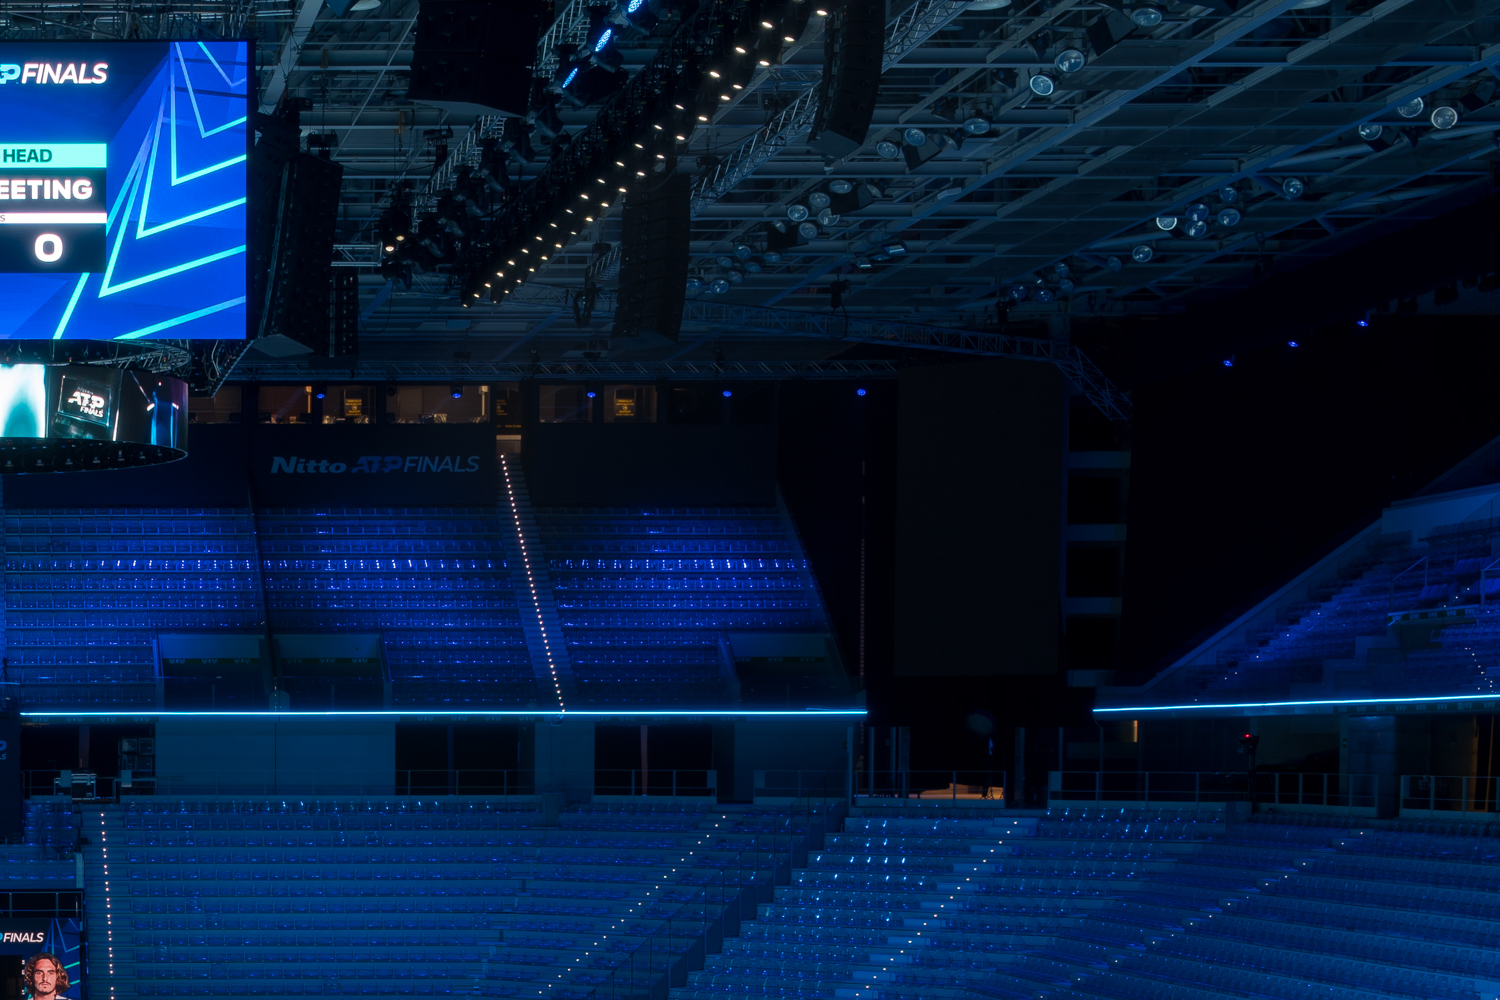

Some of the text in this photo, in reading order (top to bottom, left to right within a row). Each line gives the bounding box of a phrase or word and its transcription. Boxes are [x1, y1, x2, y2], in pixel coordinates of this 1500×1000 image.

[21, 63, 108, 84] FINALS
[2, 148, 53, 164] HEAD
[67, 390, 105, 409] ATP
[80, 406, 104, 418] FINALS
[271, 456, 480, 474] Nitto ATP FINALS
[3, 932, 44, 943] FINALS
